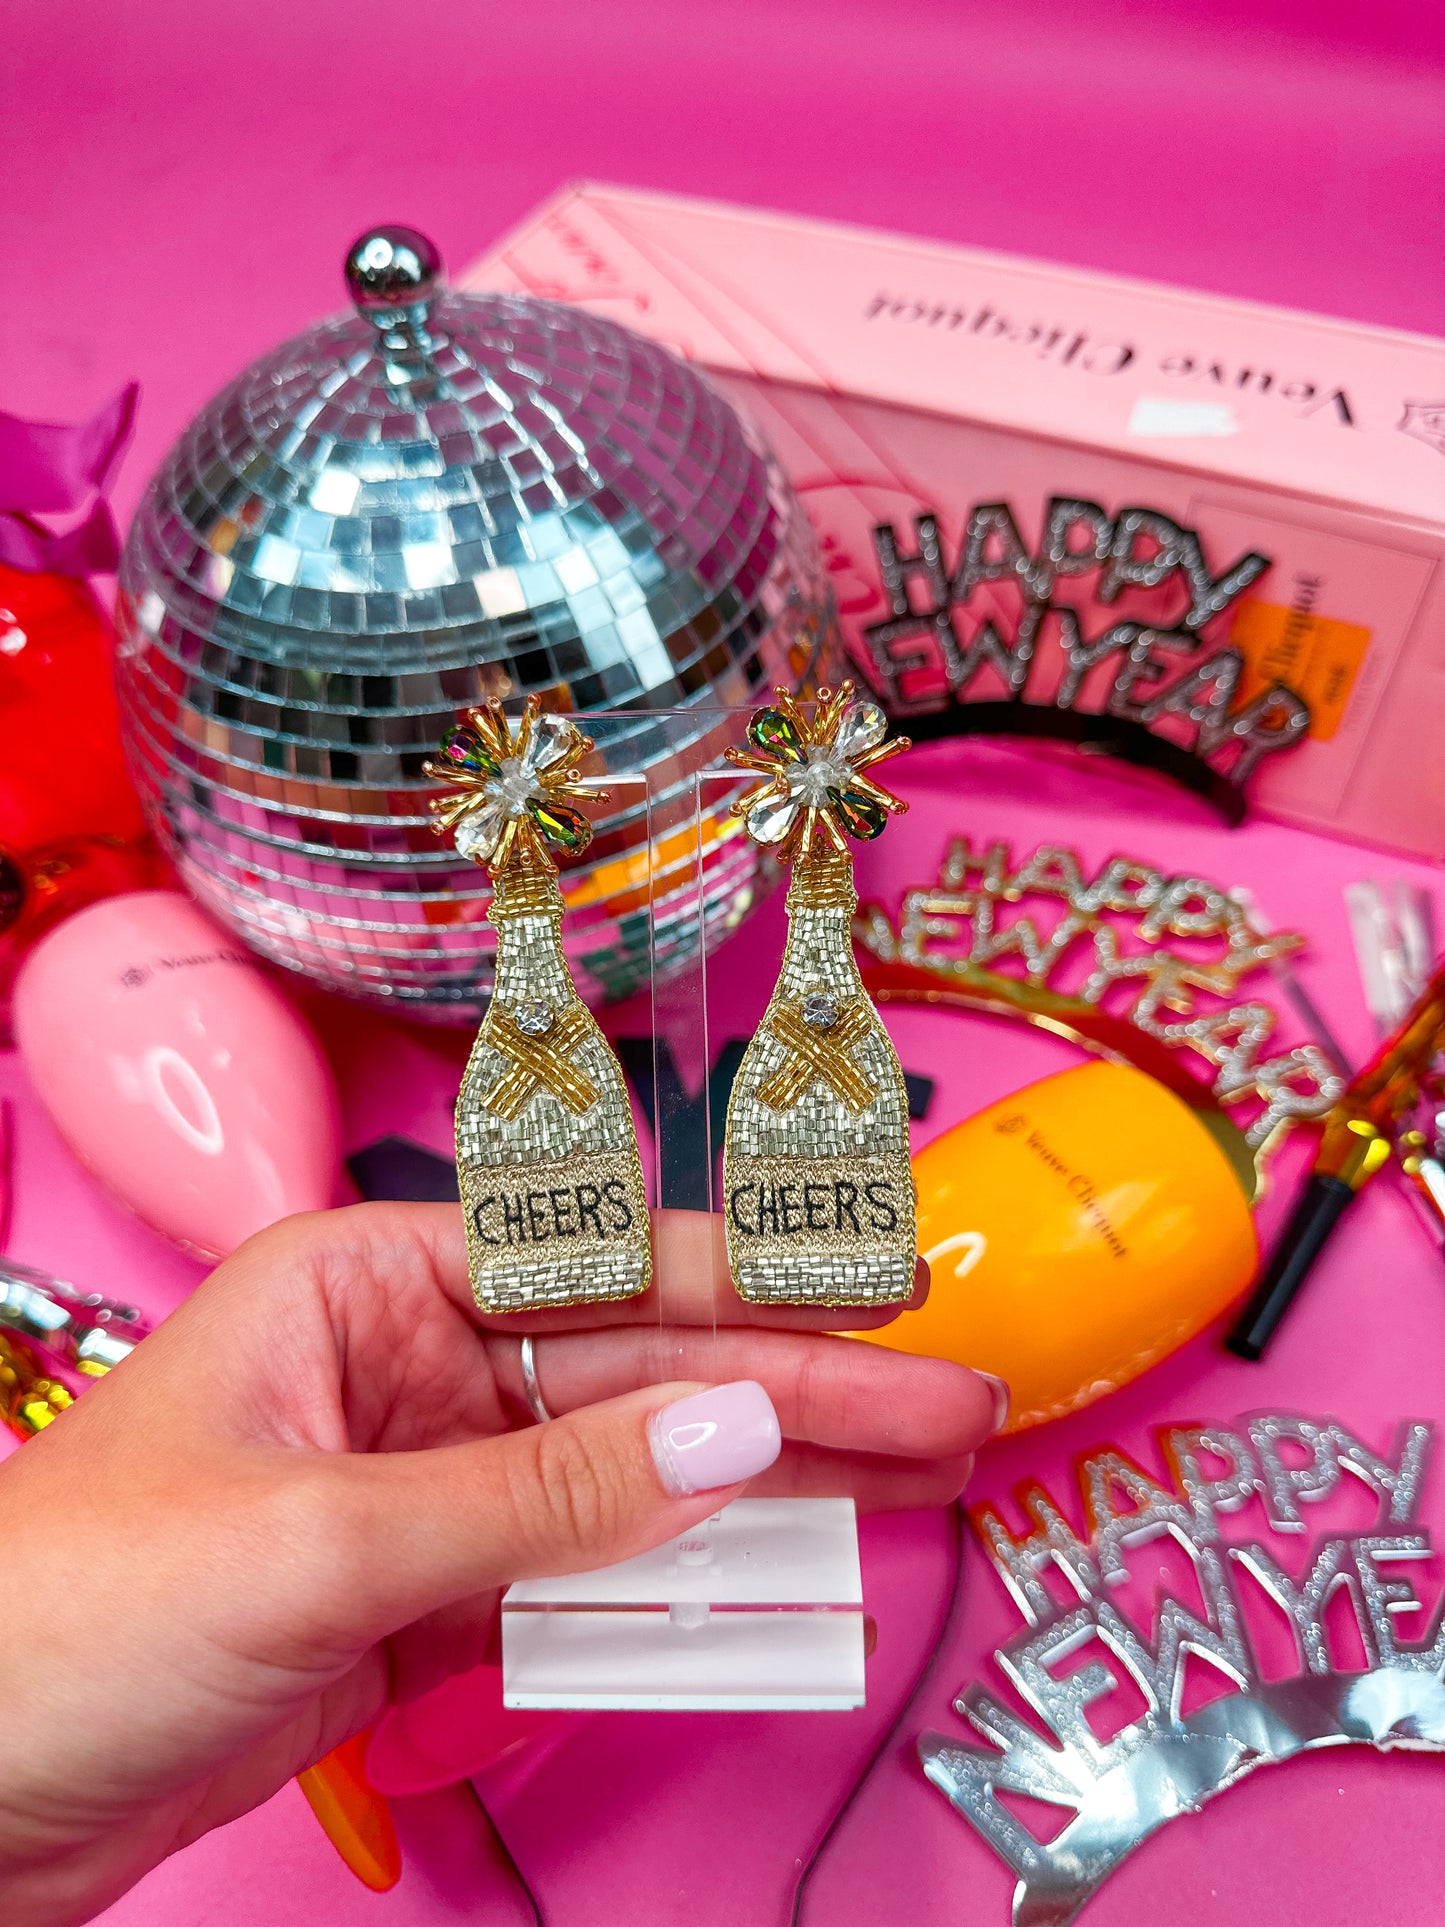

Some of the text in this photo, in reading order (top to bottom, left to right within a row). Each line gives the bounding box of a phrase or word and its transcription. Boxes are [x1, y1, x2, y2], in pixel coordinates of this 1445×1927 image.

[864, 288, 1355, 427] Veuve Clicquot
[872, 495, 1272, 630] HAPPY
[940, 832, 1308, 985] HAPPY
[474, 1180, 633, 1246] CHEERS
[730, 1179, 899, 1236] CHEERS
[966, 1408, 1434, 1628] HAPPY
